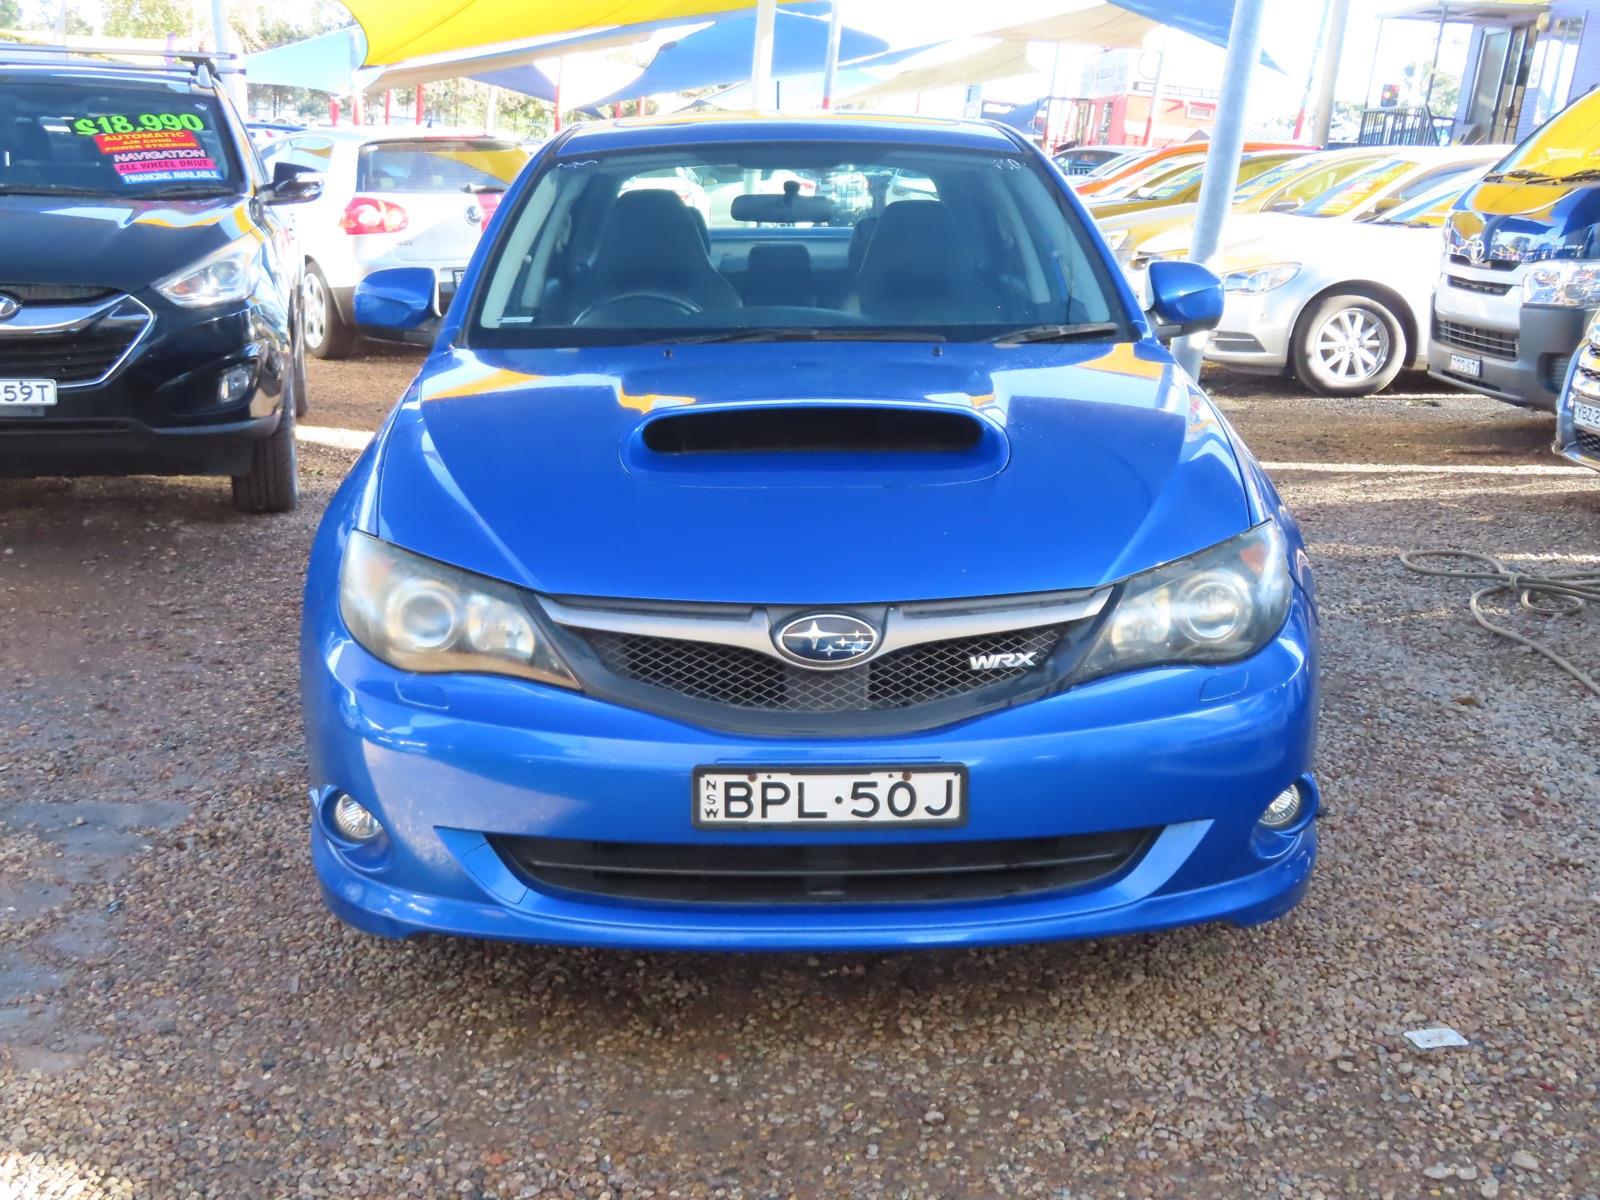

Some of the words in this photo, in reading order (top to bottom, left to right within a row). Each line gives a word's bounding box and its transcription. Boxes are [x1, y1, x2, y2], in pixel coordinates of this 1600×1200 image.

[103, 131, 186, 142] AUTOMATIC
[104, 144, 144, 152] POWER
[114, 149, 205, 162] NAVIGATION
[119, 163, 138, 172] ALL
[141, 160, 177, 170] WHEEL
[179, 159, 210, 168] DRIVE
[125, 172, 172, 183] FINANCING
[173, 170, 220, 180] AVAILABLE
[969, 651, 1038, 671] WRX
